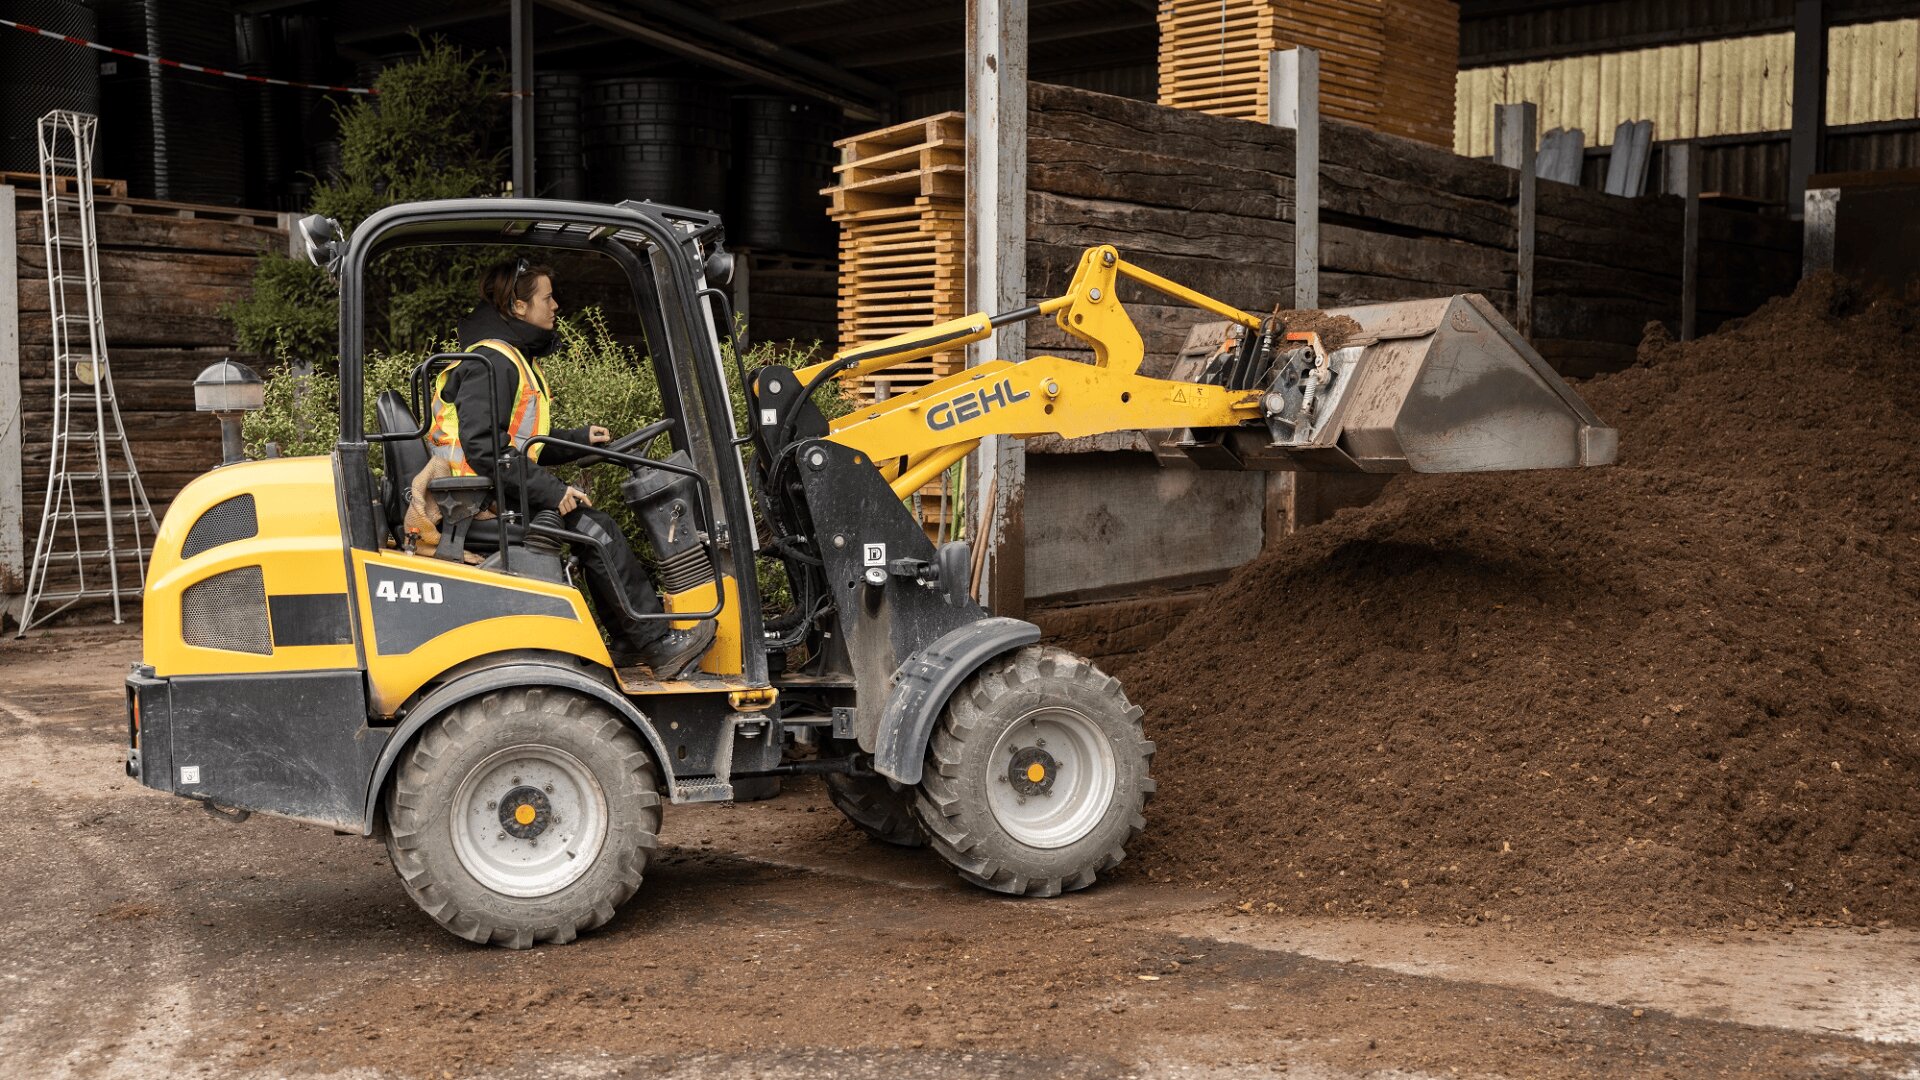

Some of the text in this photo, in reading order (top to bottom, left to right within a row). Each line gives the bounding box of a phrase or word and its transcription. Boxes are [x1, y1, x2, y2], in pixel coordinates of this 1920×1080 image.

[926, 379, 1030, 431] GEHL
[868, 547, 882, 561] D
[376, 581, 444, 604] 440
